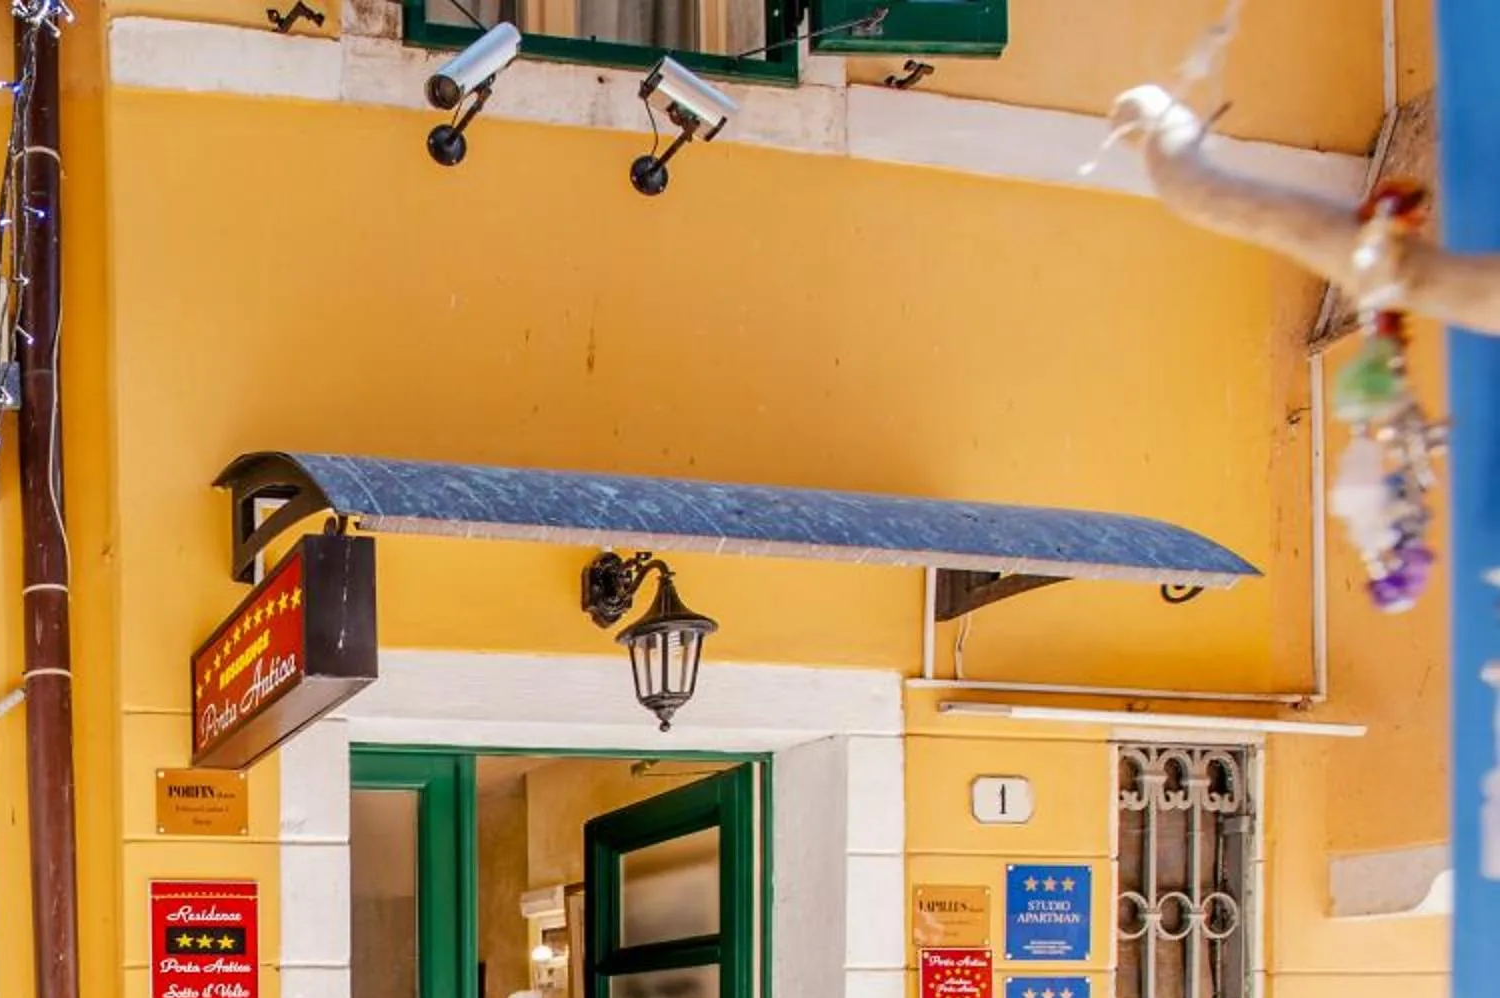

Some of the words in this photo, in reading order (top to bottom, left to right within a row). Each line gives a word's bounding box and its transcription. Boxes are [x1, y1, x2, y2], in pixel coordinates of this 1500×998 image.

[199, 698, 237, 749] Porta
[240, 653, 297, 713] Antica
[166, 904, 243, 923] Residence
[1027, 899, 1072, 912] STUDIO
[1016, 911, 1082, 925] APARTMAN
[159, 957, 201, 974] Porta
[202, 957, 252, 974] Antica
